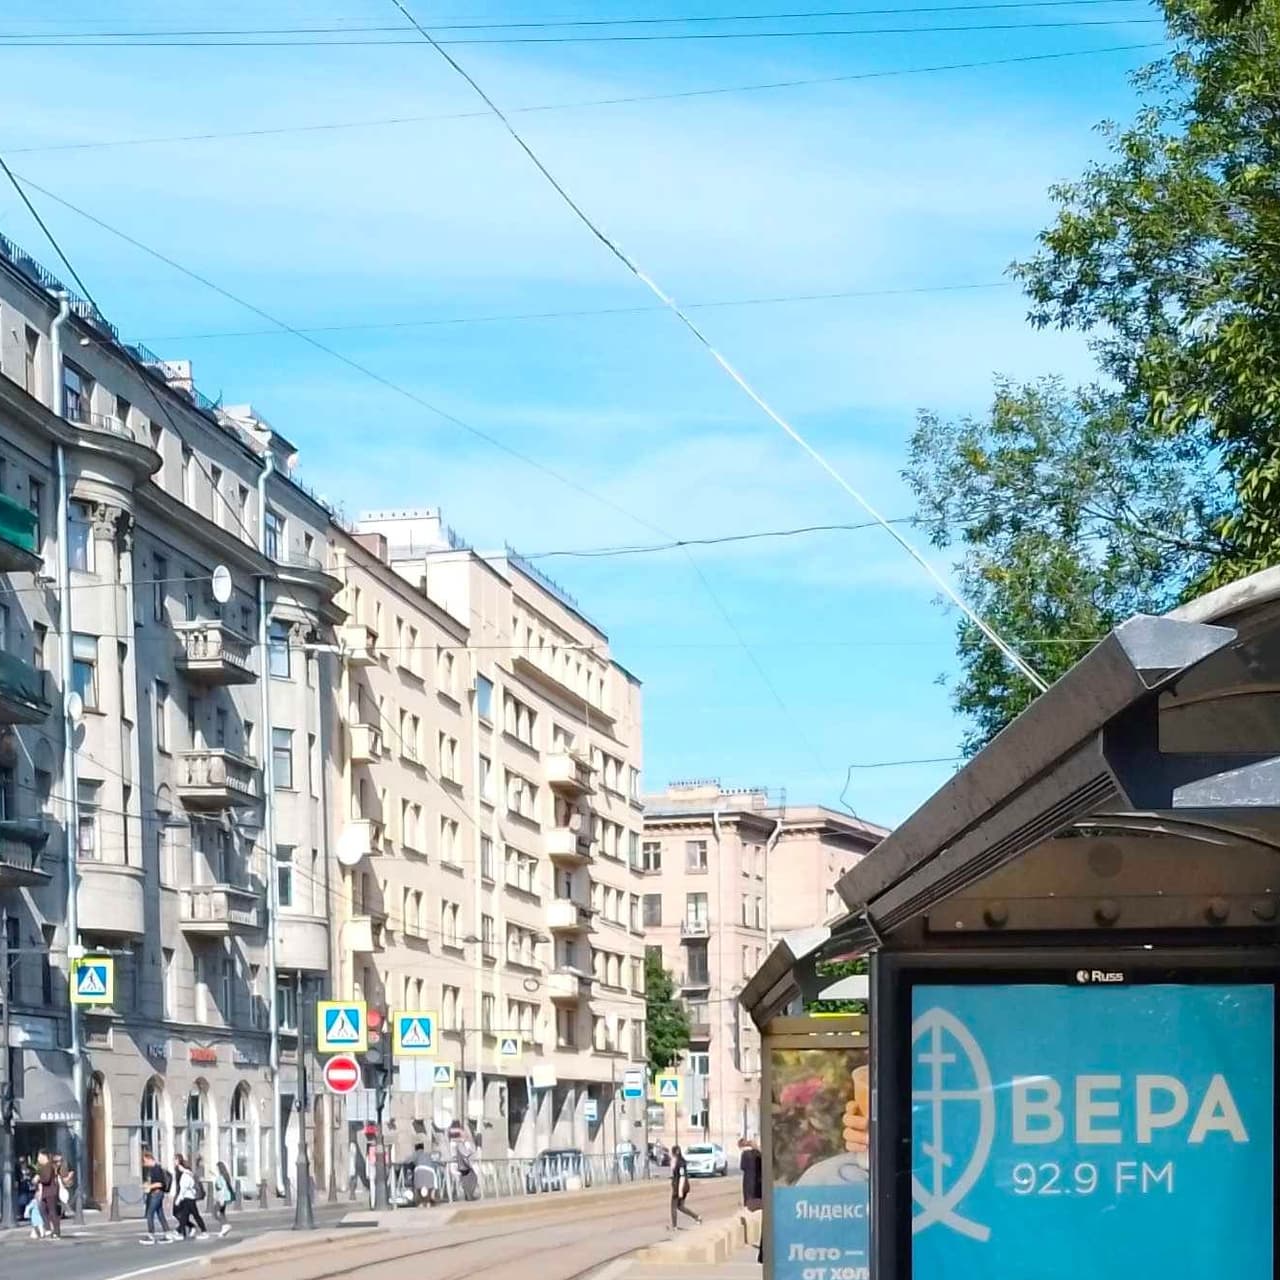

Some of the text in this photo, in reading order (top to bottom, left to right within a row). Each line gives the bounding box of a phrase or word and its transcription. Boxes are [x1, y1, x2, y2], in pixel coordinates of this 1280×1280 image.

[1091, 970, 1124, 982] Russ
[1012, 1074, 1250, 1144] ВЕРА
[1013, 1161, 1174, 1195] 92.9 FM
[795, 1200, 863, 1221] Яндекс
[788, 1243, 841, 1262] Лето
[830, 1267, 870, 1280] хол
